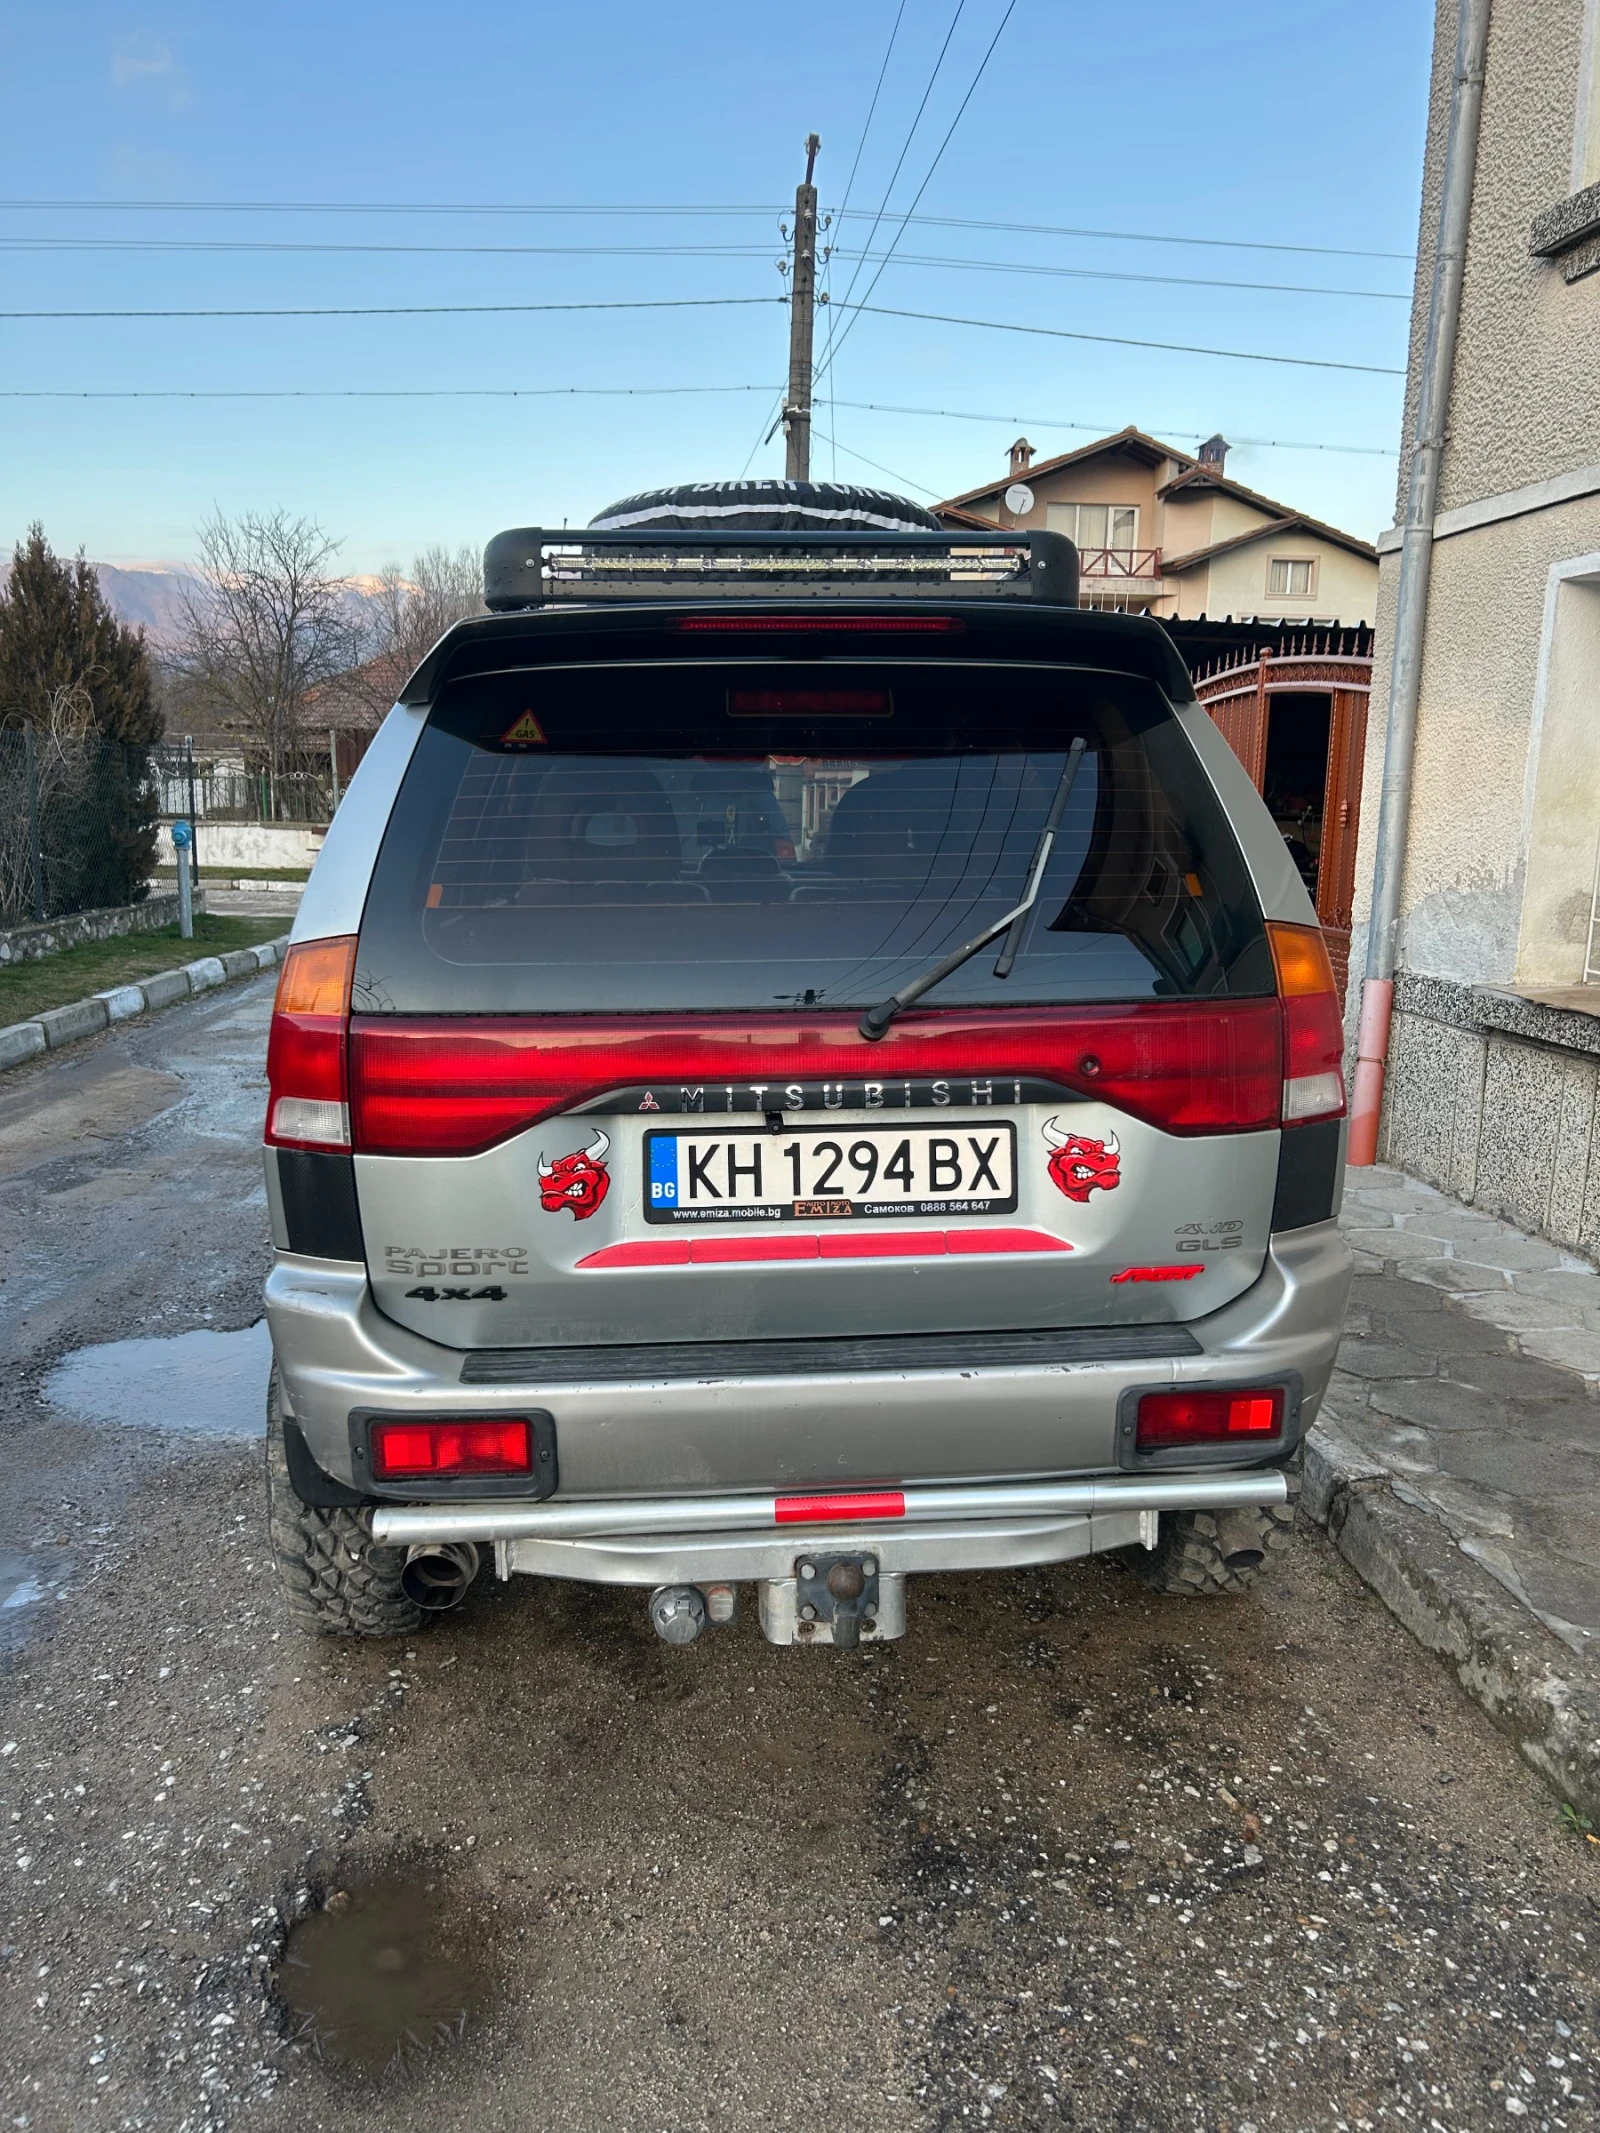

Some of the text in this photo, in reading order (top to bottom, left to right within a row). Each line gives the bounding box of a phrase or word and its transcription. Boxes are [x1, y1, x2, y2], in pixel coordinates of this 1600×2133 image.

[515, 729, 535, 739] GAS
[681, 1079, 1021, 1112] MITSUBISHI
[688, 1137, 1000, 1199] KH 1294 BX
[651, 1182, 676, 1199] BG
[673, 1207, 781, 1219] www.emiza.mobile.bg
[794, 1201, 853, 1217] EMIZA
[864, 1200, 991, 1214] Самоков 0888 564 647
[384, 1245, 528, 1259] PAJERO
[1175, 1236, 1243, 1252] GLS
[405, 1285, 508, 1302] 4x4
